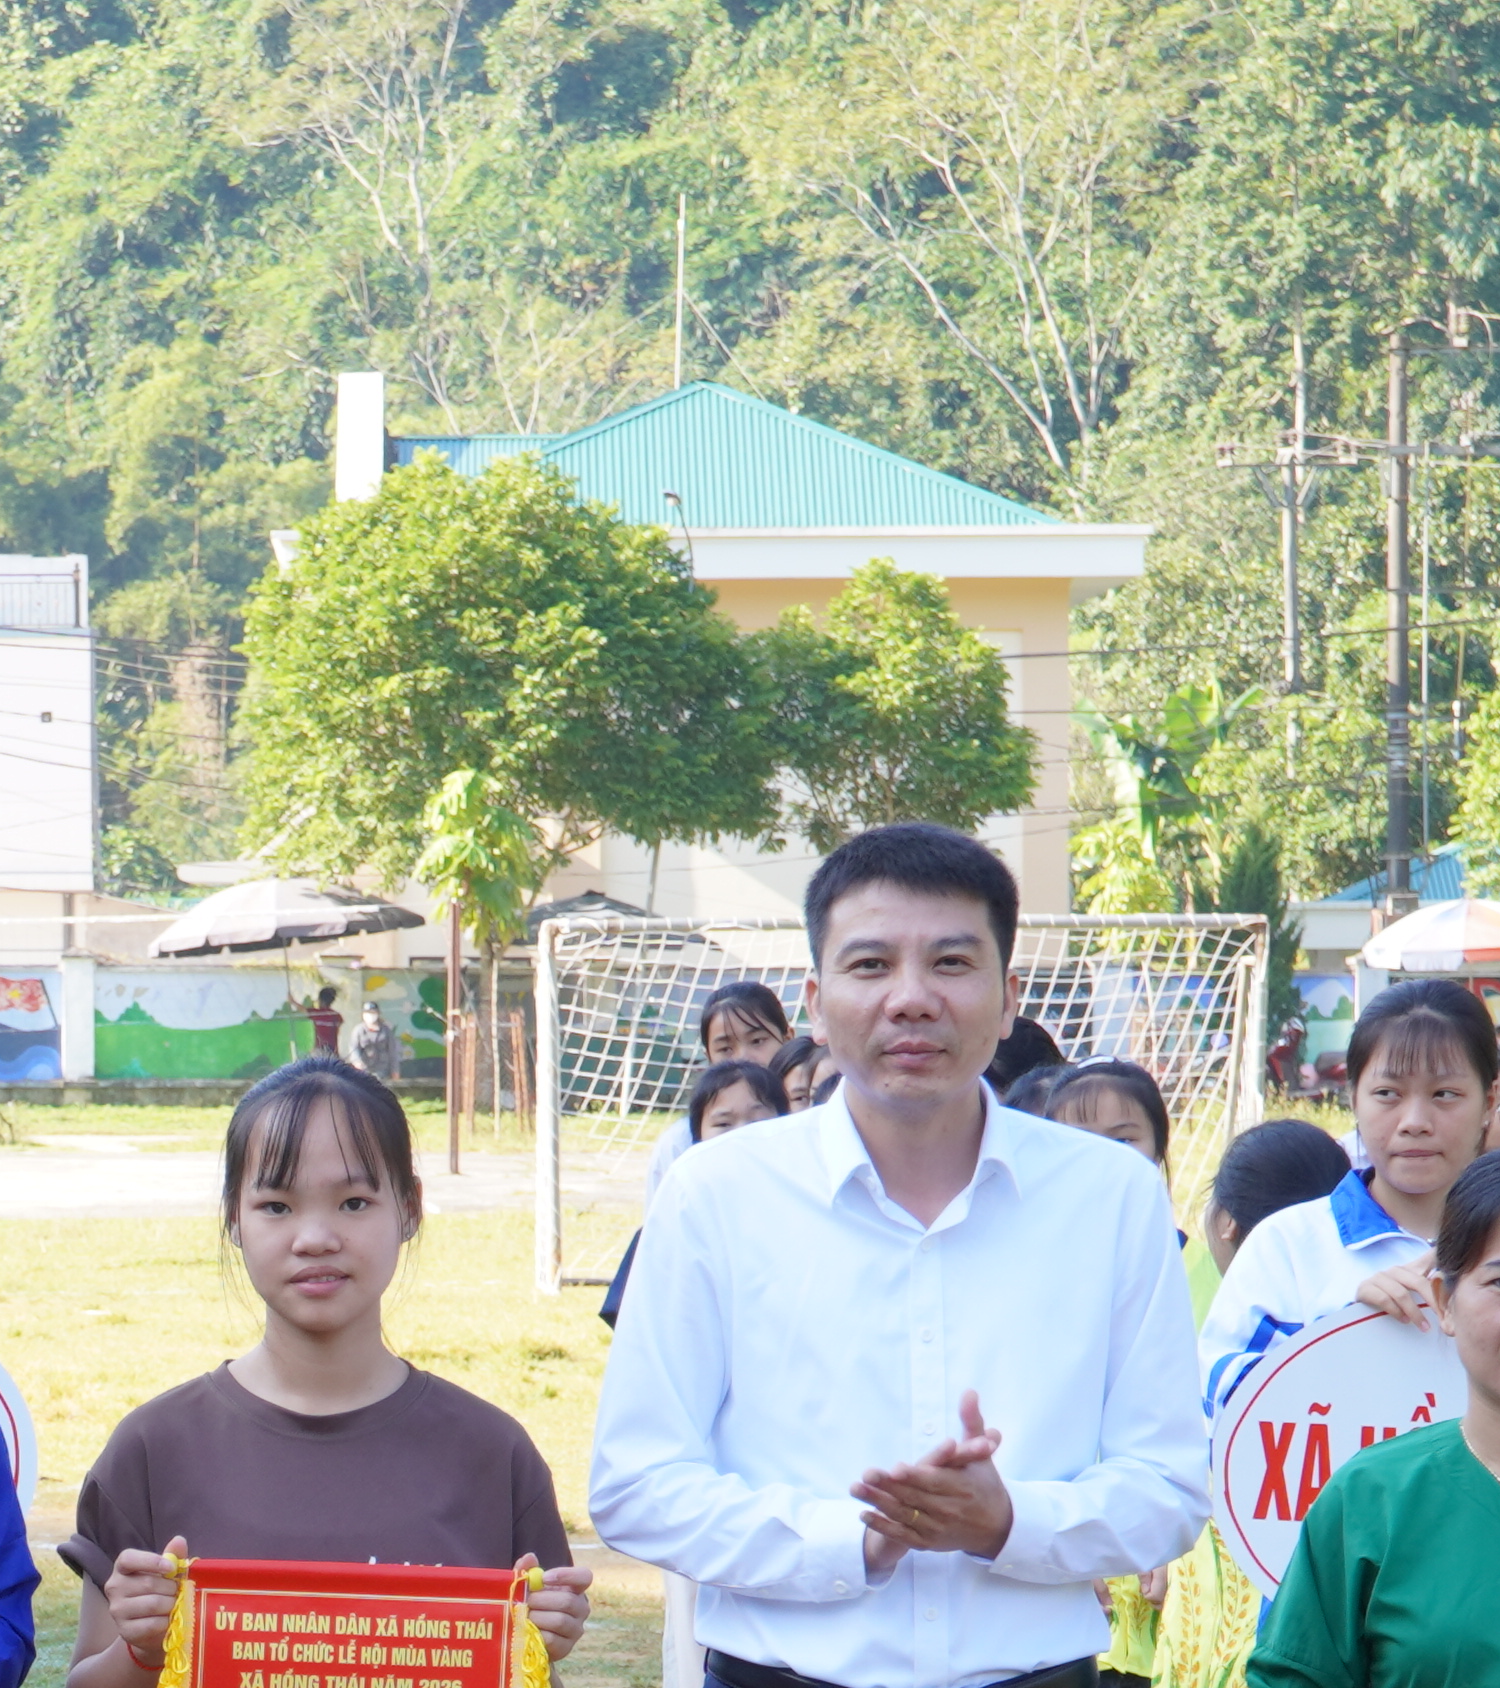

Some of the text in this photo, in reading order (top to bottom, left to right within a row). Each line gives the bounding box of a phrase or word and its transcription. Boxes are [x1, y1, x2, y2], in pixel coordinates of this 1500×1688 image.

[1252, 1402, 1333, 1522] XÃ
[215, 1605, 493, 1640] ỦY BAN NHÂN DÂN XÃ HỒNG THÁI
[232, 1635, 473, 1669] BAN TỔ CHỨC LỄ HỘI MÙA VÀNG
